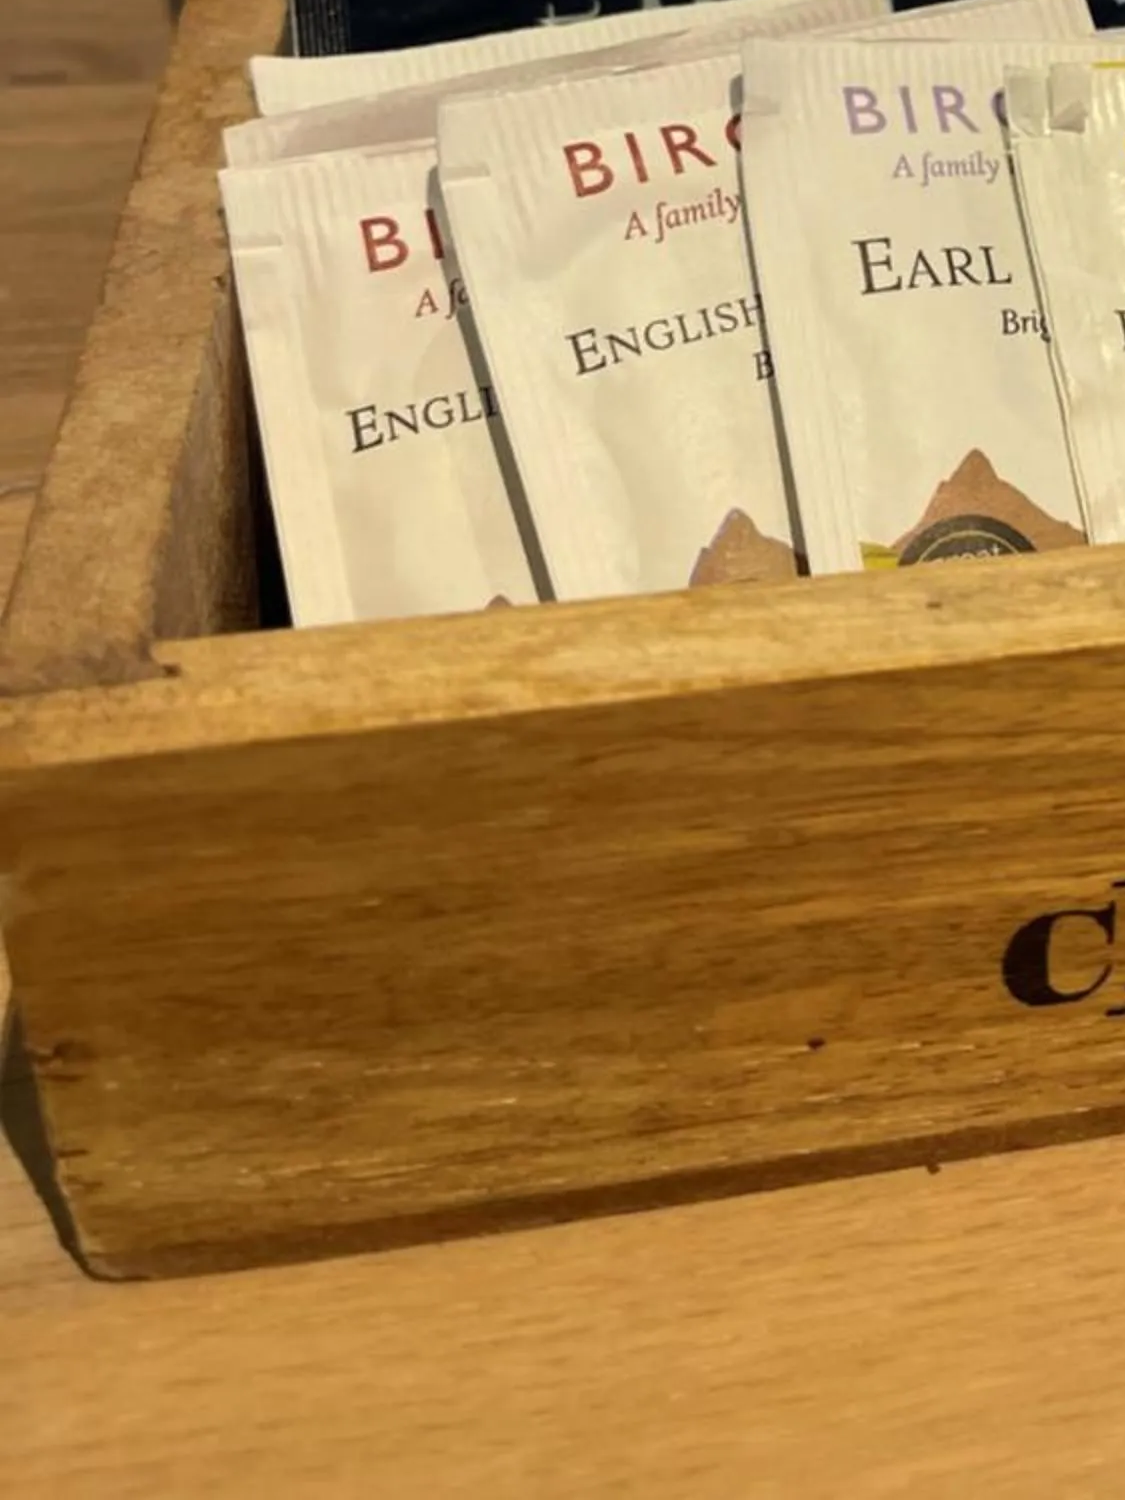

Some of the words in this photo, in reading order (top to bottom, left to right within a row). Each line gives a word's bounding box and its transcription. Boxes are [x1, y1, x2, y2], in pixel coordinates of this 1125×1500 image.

[891, 153, 915, 180] A
[920, 150, 1001, 187] family
[624, 210, 649, 241] A
[654, 186, 742, 244] family
[850, 235, 1014, 296] EARL
[414, 287, 440, 319] A
[564, 293, 763, 376] ENGLISH
